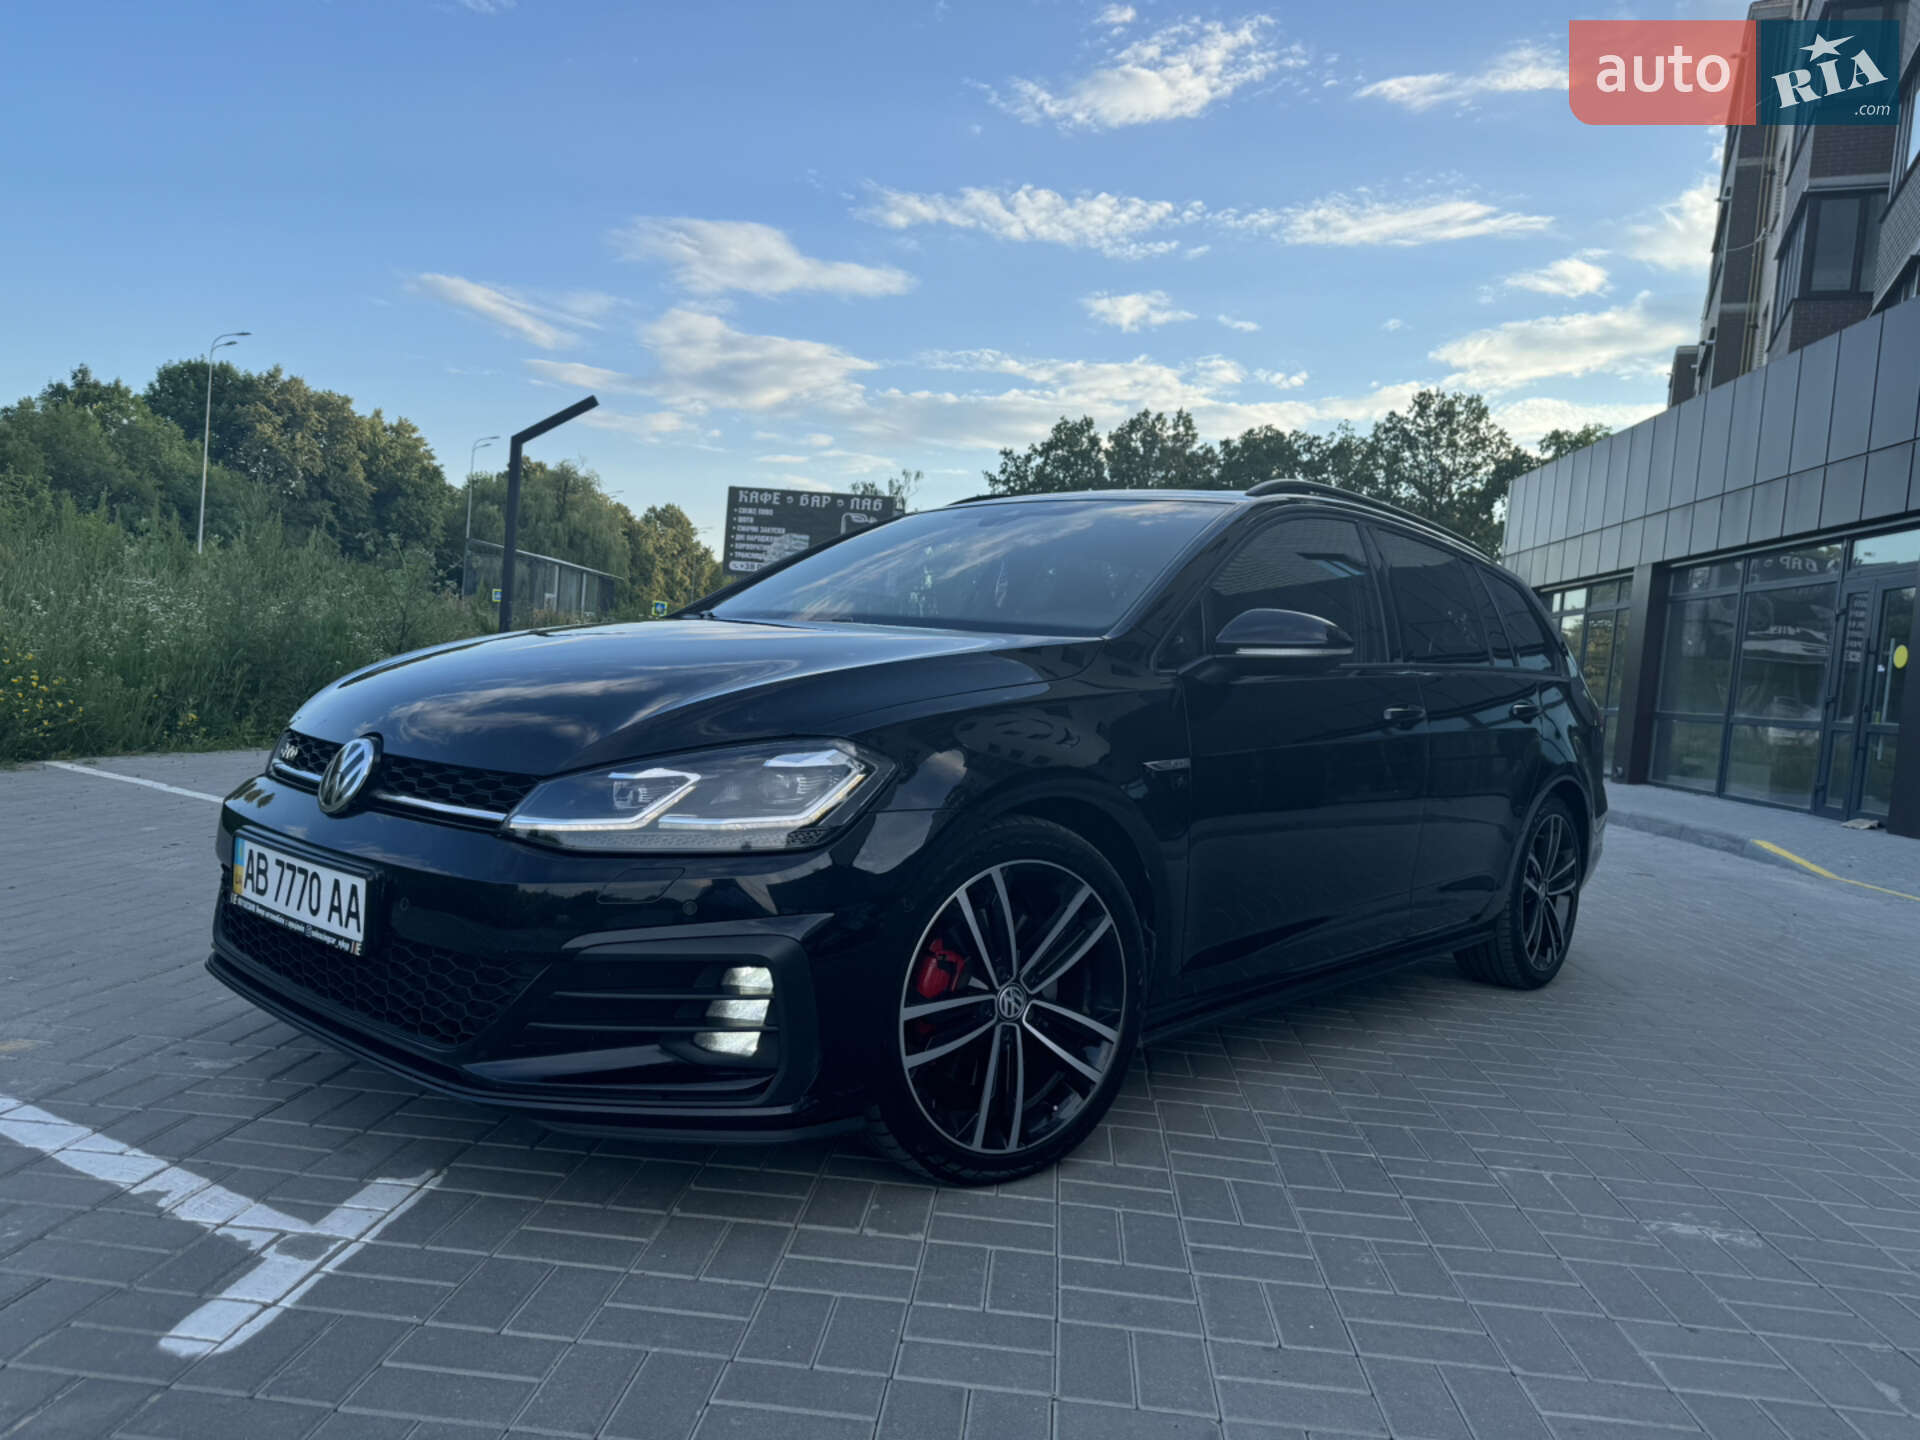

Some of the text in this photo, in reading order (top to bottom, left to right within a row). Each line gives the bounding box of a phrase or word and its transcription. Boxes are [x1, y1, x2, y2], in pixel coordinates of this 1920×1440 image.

[738, 490, 883, 511] КАФЕ БАР ПАБ
[244, 848, 361, 933] AB 7770 AA
